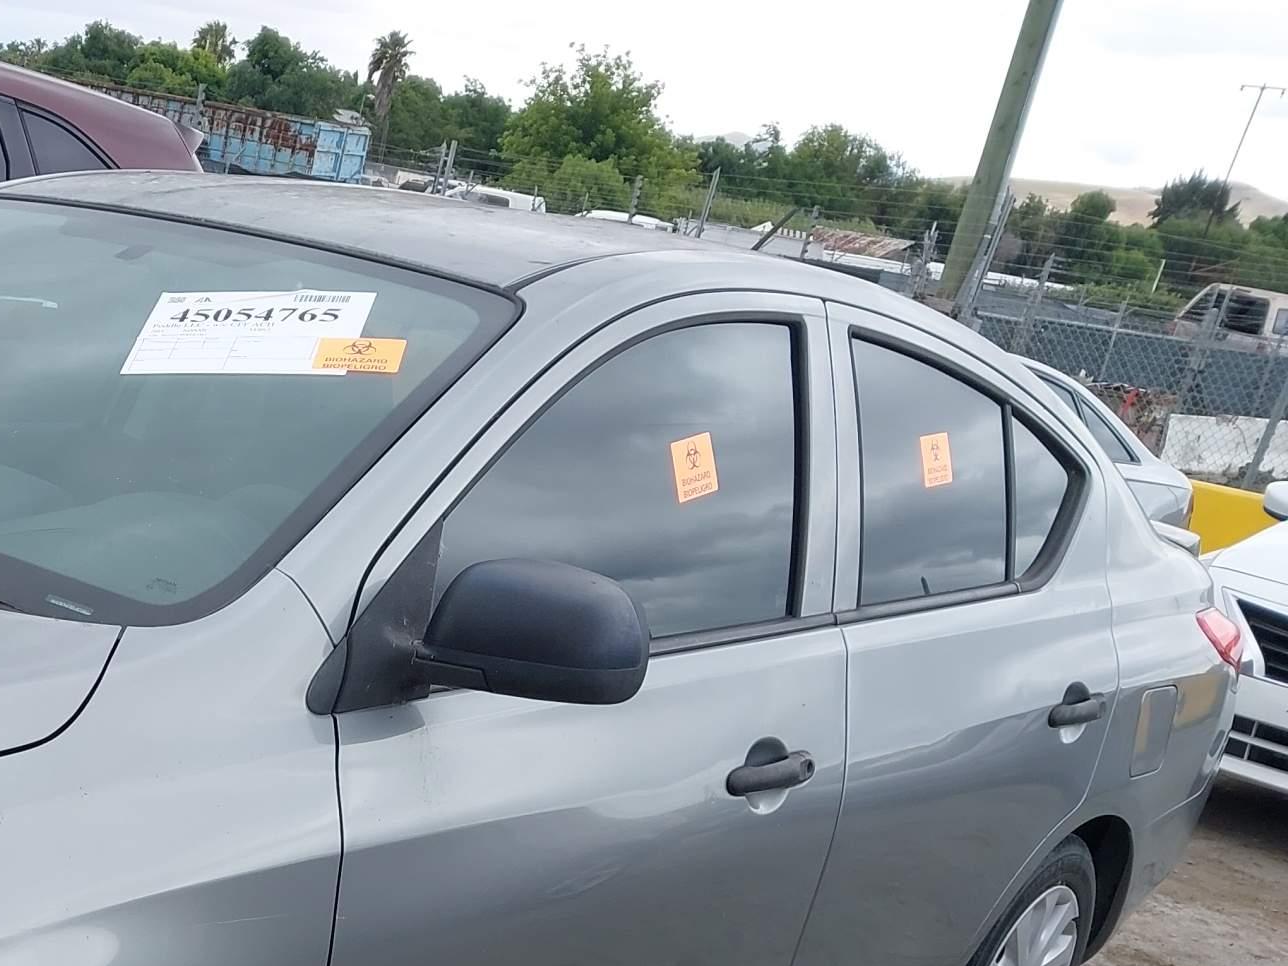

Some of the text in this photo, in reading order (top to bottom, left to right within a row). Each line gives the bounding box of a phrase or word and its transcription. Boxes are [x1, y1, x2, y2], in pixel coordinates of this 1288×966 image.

[169, 307, 343, 323] 45054765
[324, 356, 388, 365] BIOHAZARD
[321, 363, 387, 371] BIOPELIGRO
